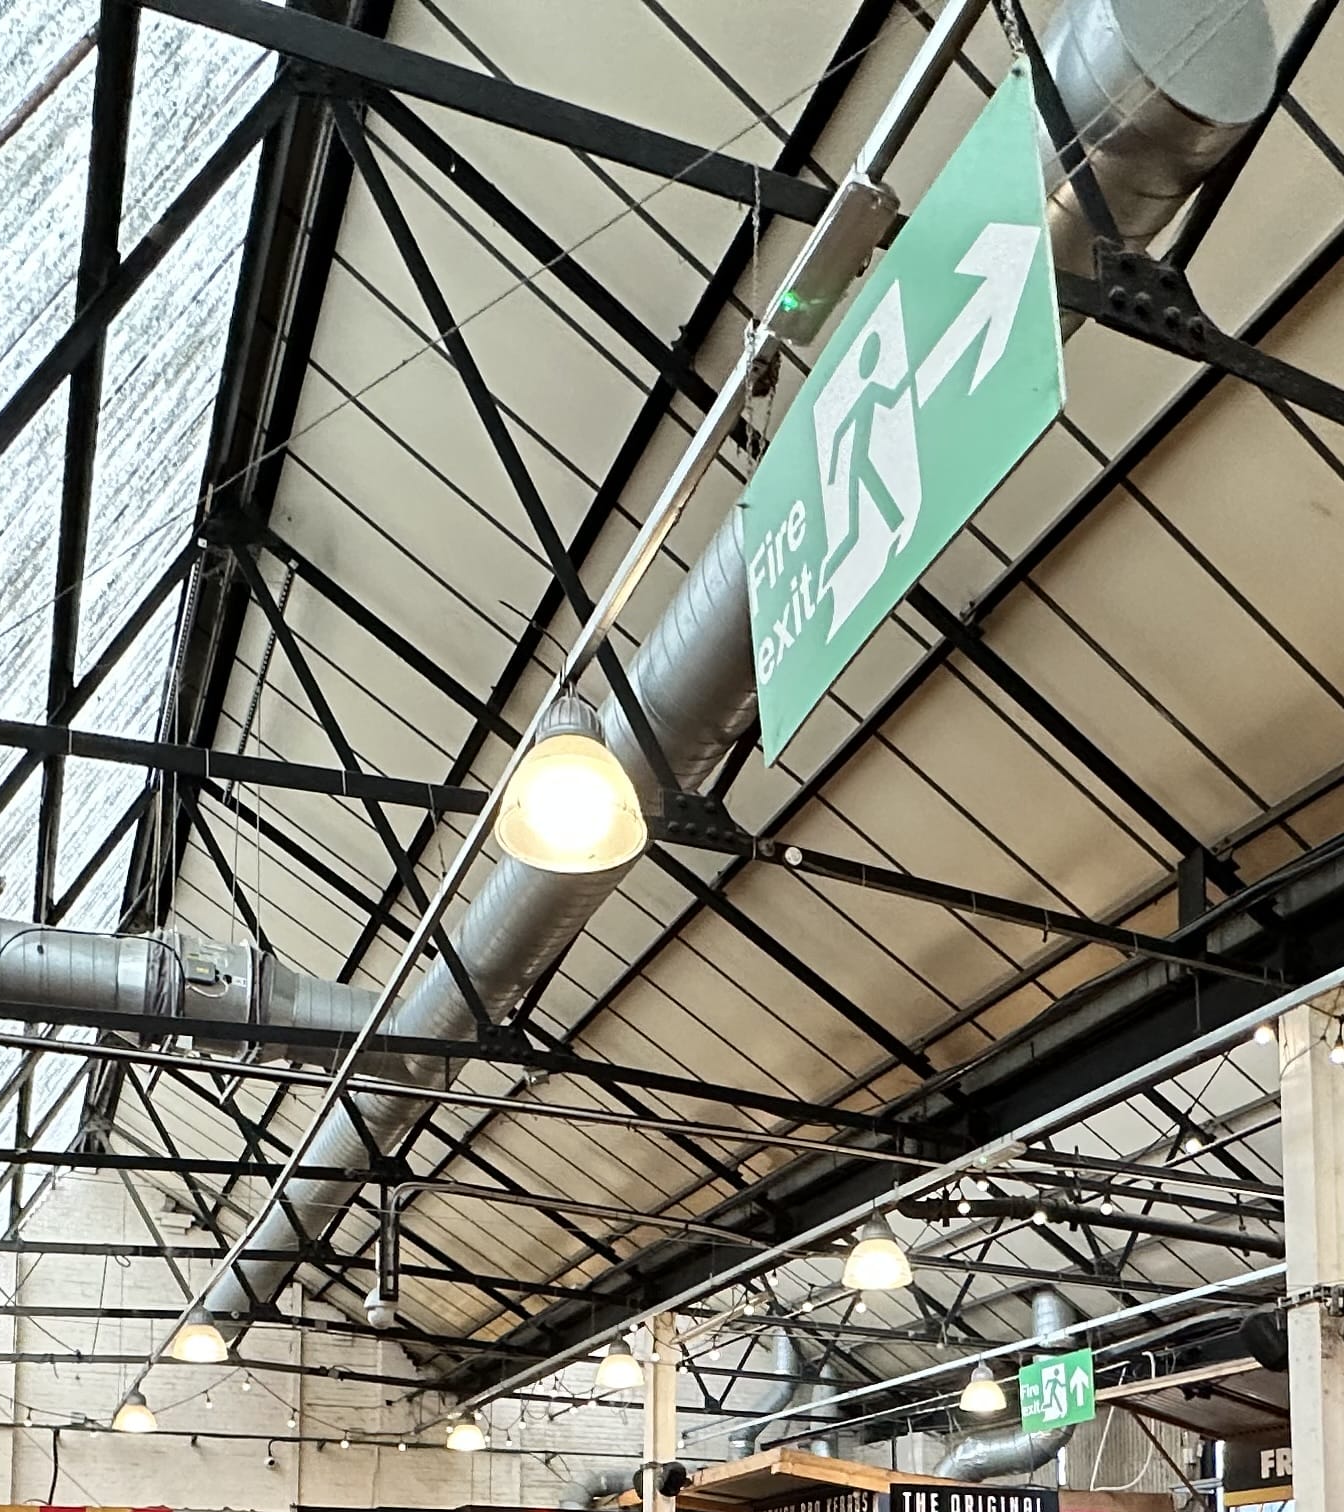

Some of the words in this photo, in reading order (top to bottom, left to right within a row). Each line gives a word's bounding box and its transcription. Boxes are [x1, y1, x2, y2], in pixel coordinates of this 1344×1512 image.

[748, 499, 806, 618] Fire
[757, 563, 816, 685] exit
[1021, 1383, 1040, 1399] Fire
[1023, 1399, 1041, 1416] exit
